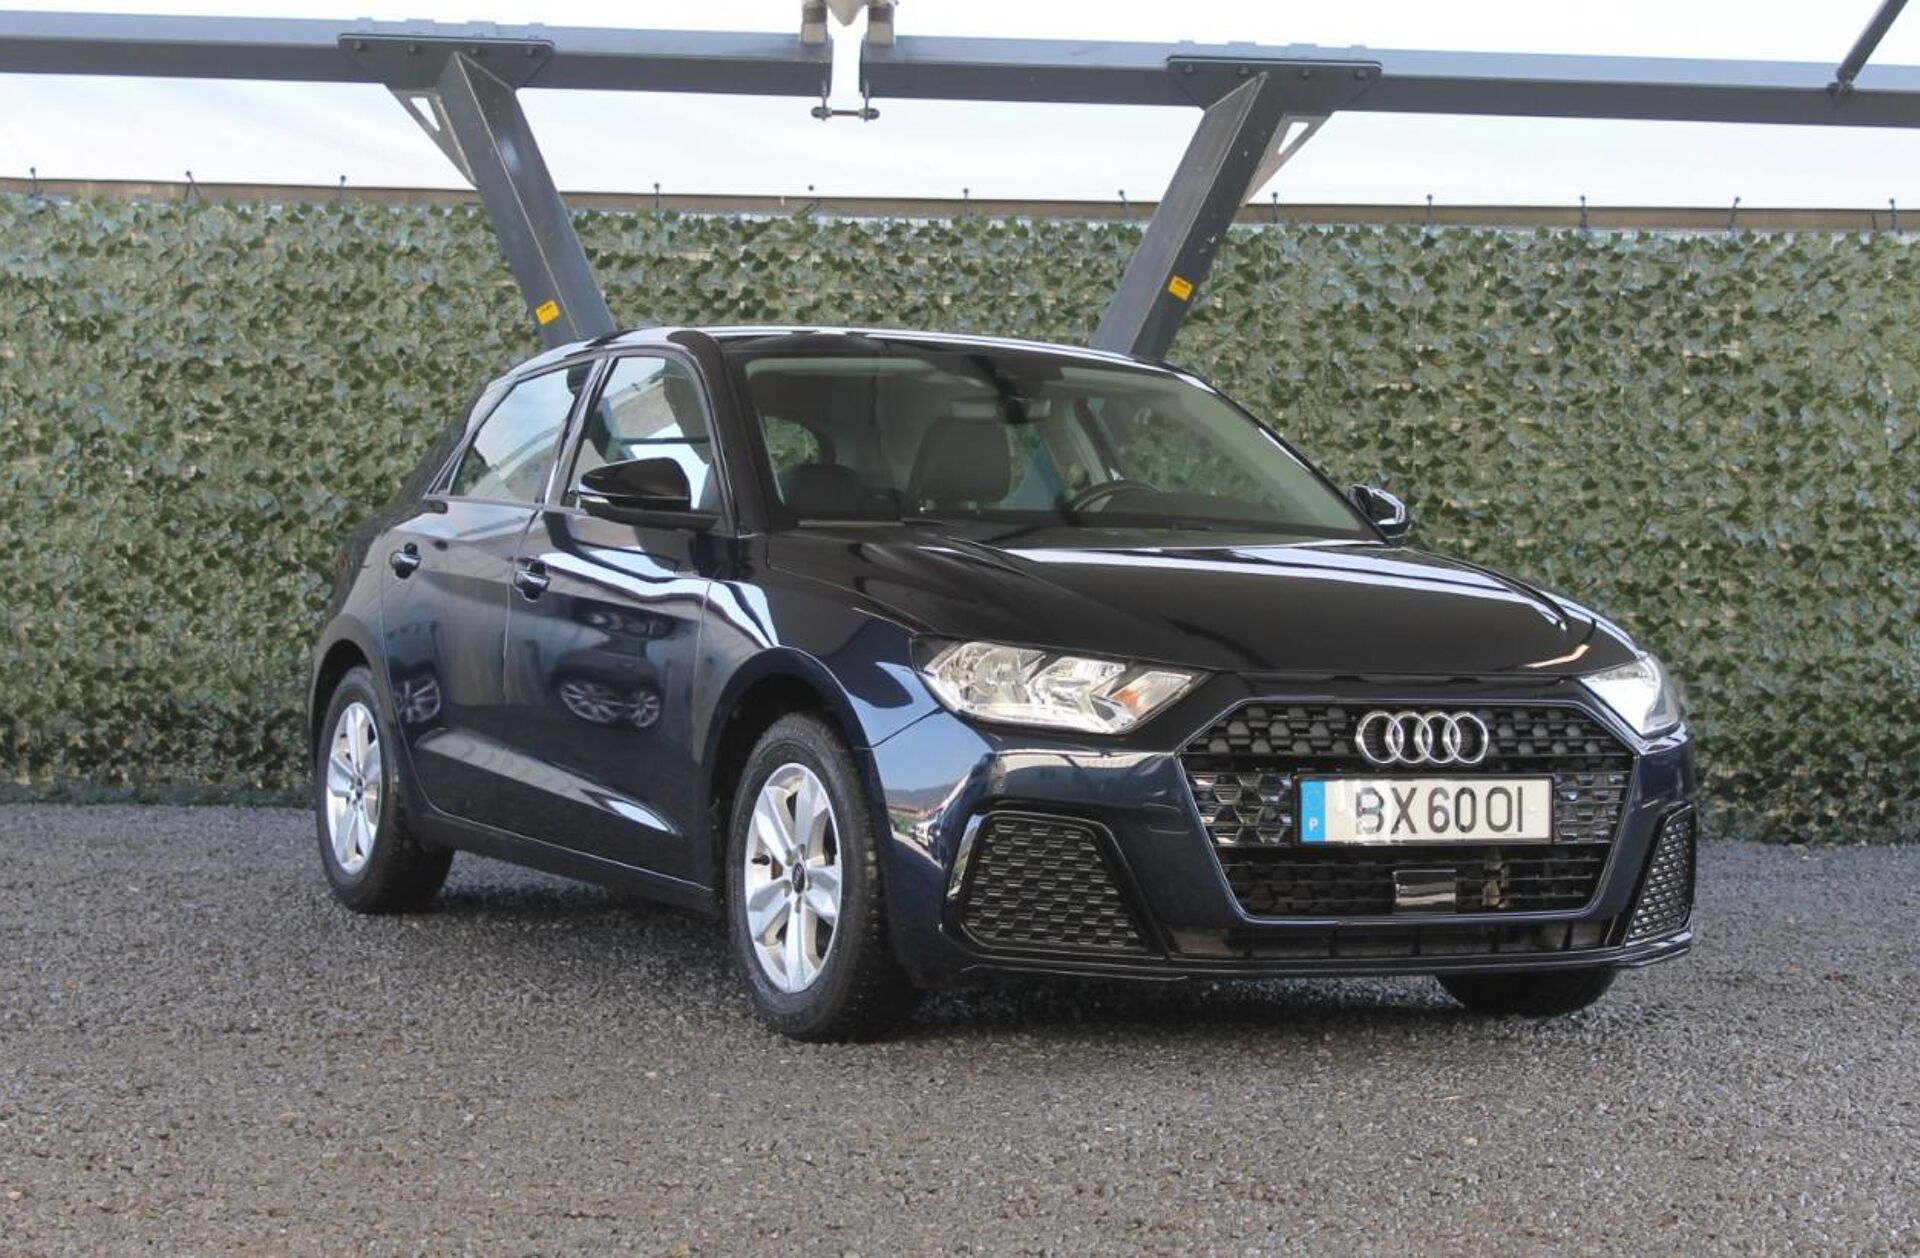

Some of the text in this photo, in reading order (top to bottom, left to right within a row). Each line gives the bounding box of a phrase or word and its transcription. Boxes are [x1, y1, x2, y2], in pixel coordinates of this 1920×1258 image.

[1309, 817, 1318, 831] P
[1356, 787, 1418, 834] BX
[1428, 787, 1477, 833] 60
